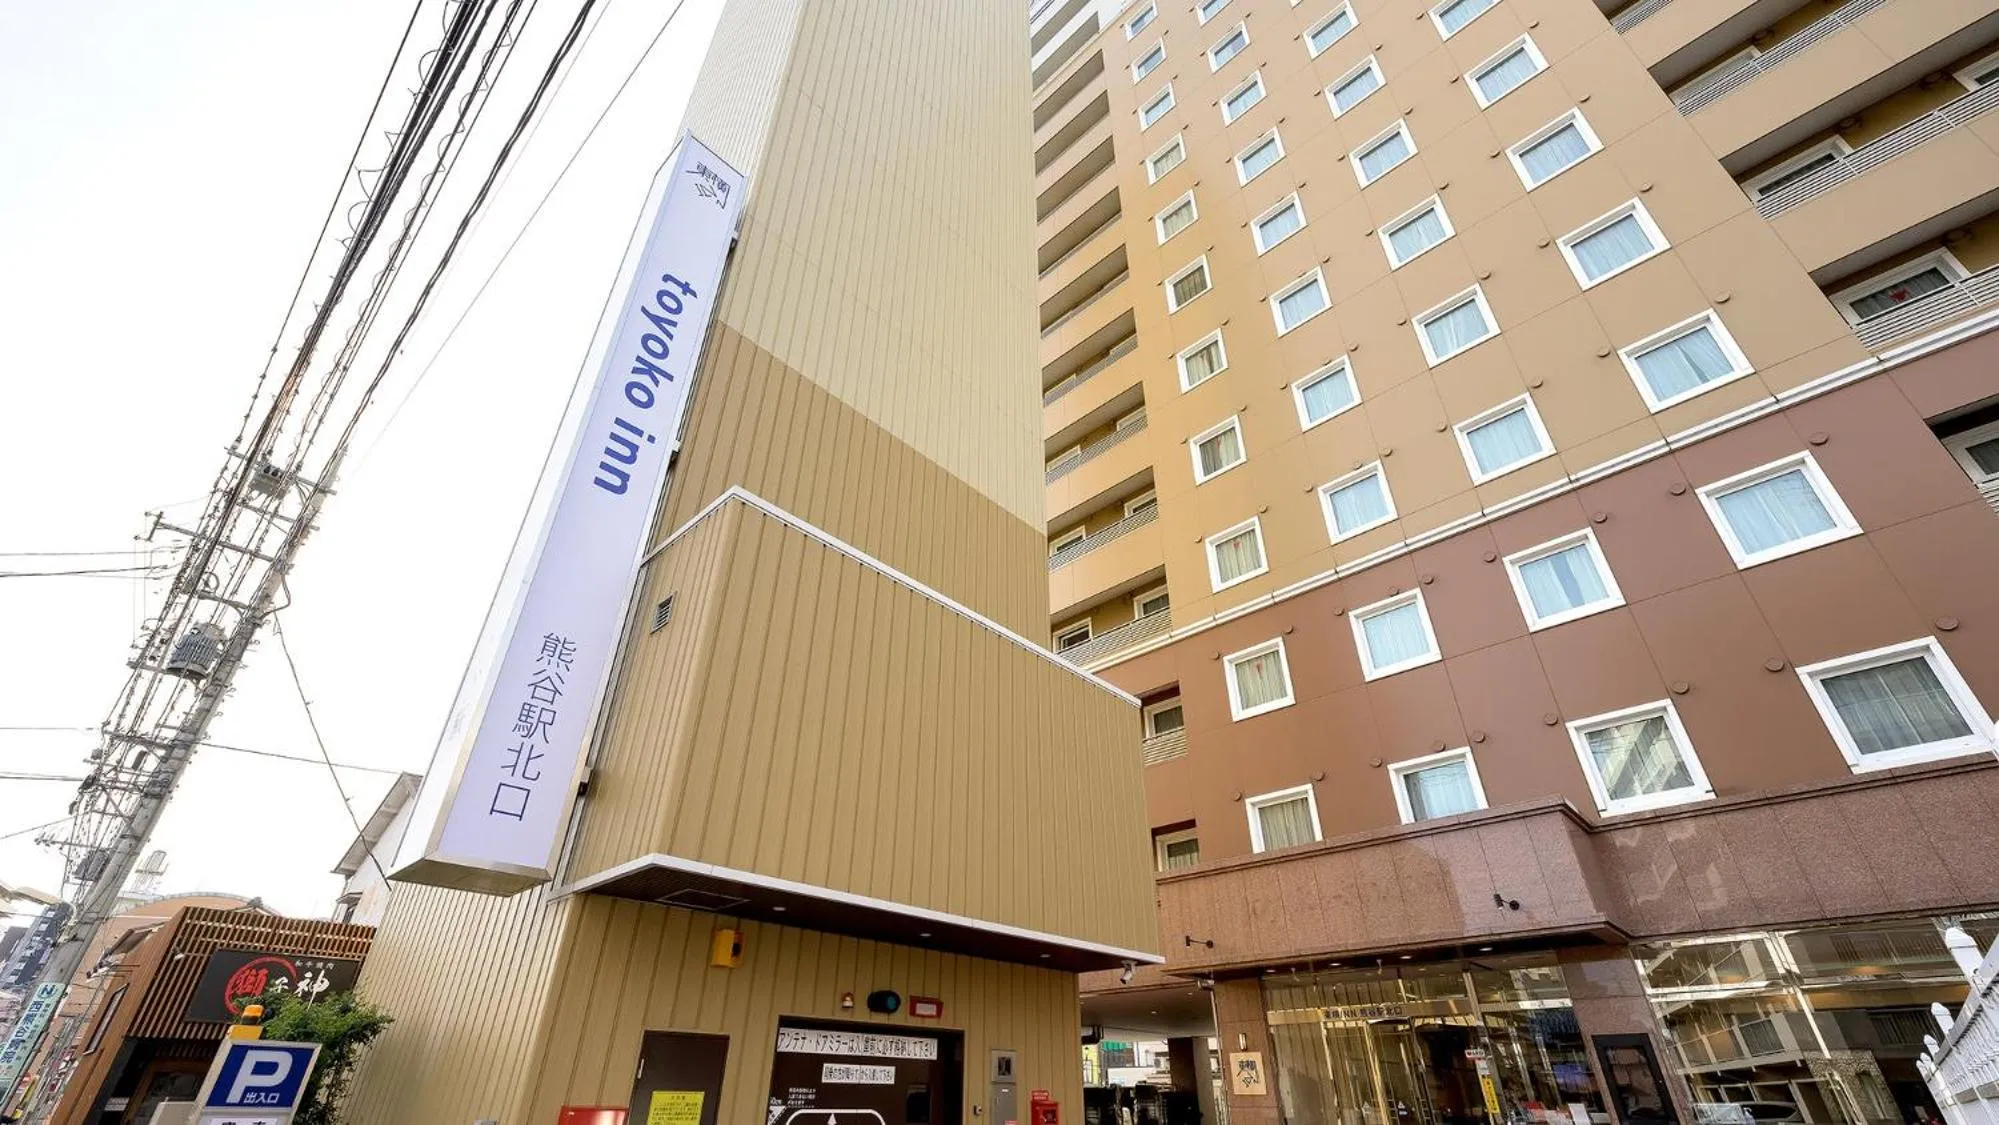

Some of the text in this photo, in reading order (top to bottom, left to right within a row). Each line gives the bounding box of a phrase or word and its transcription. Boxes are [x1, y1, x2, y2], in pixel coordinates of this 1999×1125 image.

[593, 273, 698, 495] toyoko inn
[490, 632, 577, 821] 熊谷駅北口
[226, 1050, 293, 1104] P
[243, 1092, 280, 1104] 出入口
